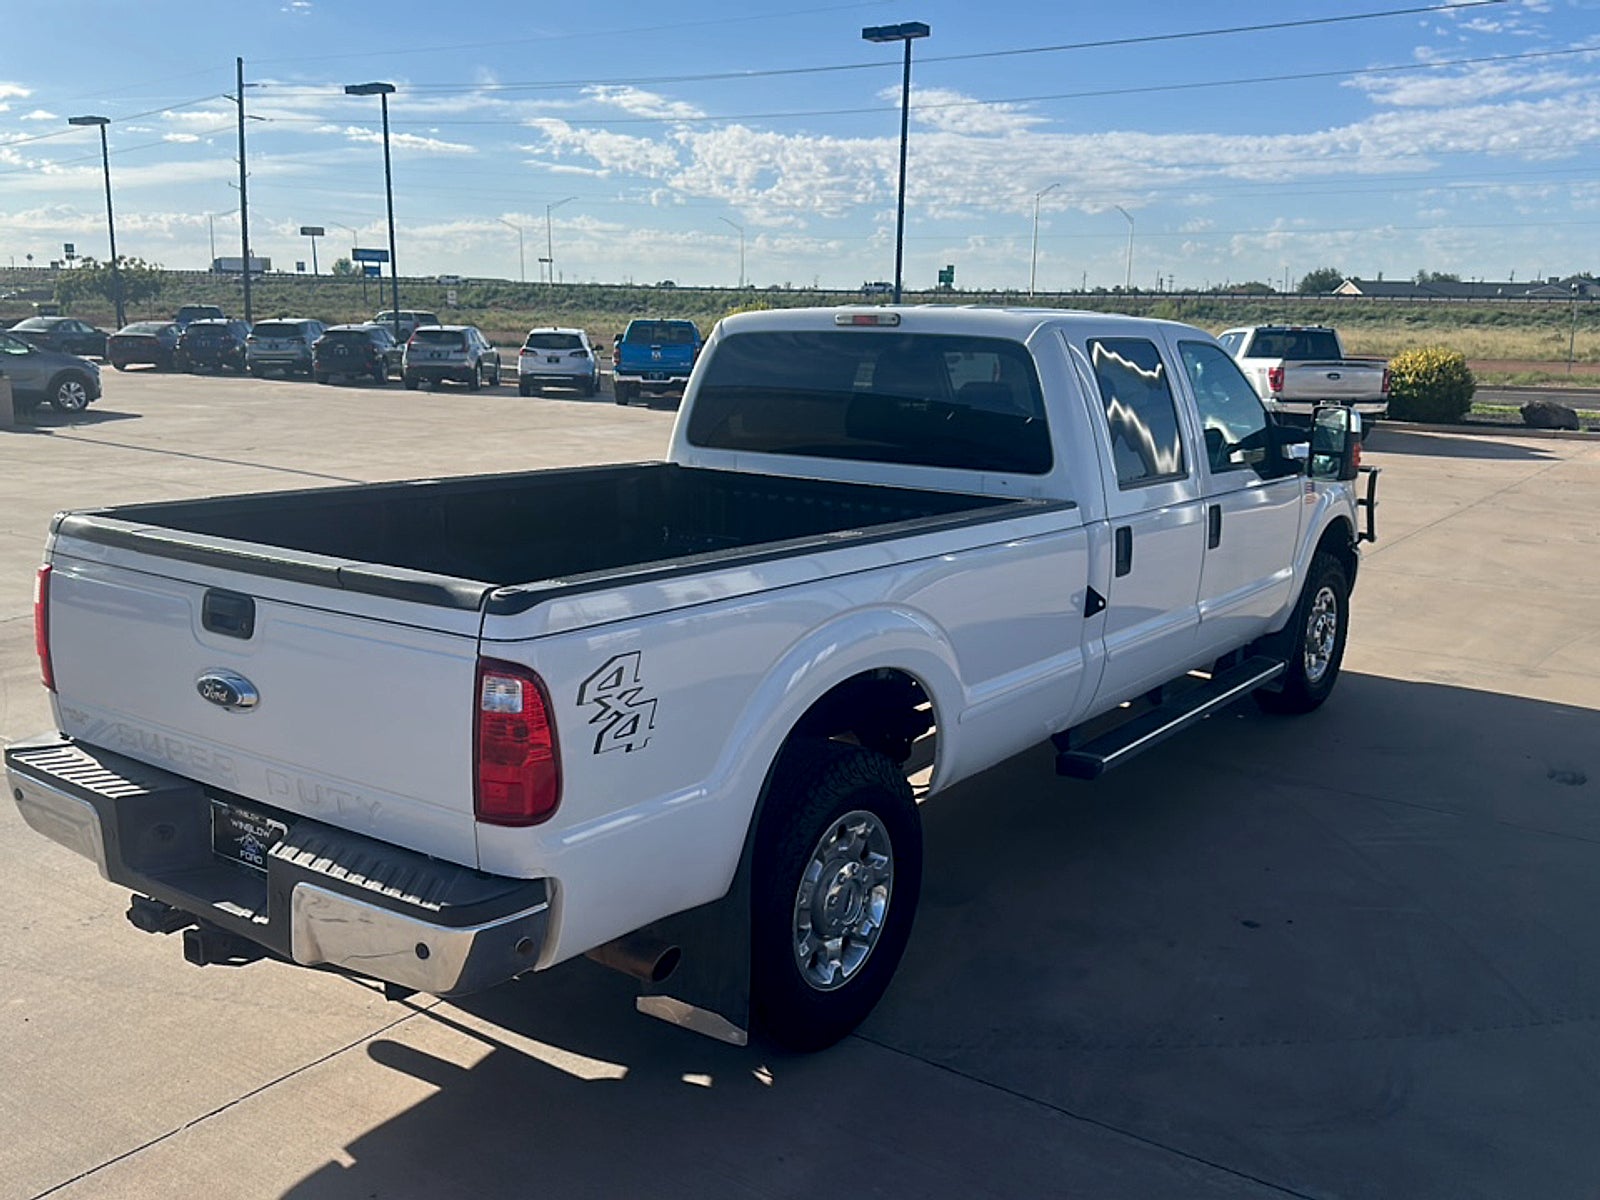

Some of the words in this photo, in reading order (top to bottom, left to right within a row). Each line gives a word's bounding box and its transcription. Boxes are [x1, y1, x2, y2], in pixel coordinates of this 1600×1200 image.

[202, 683, 230, 702] Ford
[114, 722, 240, 785] SUPER
[264, 766, 386, 828] DUTY
[230, 818, 273, 838] WINSLOW
[240, 849, 263, 865] FORD
